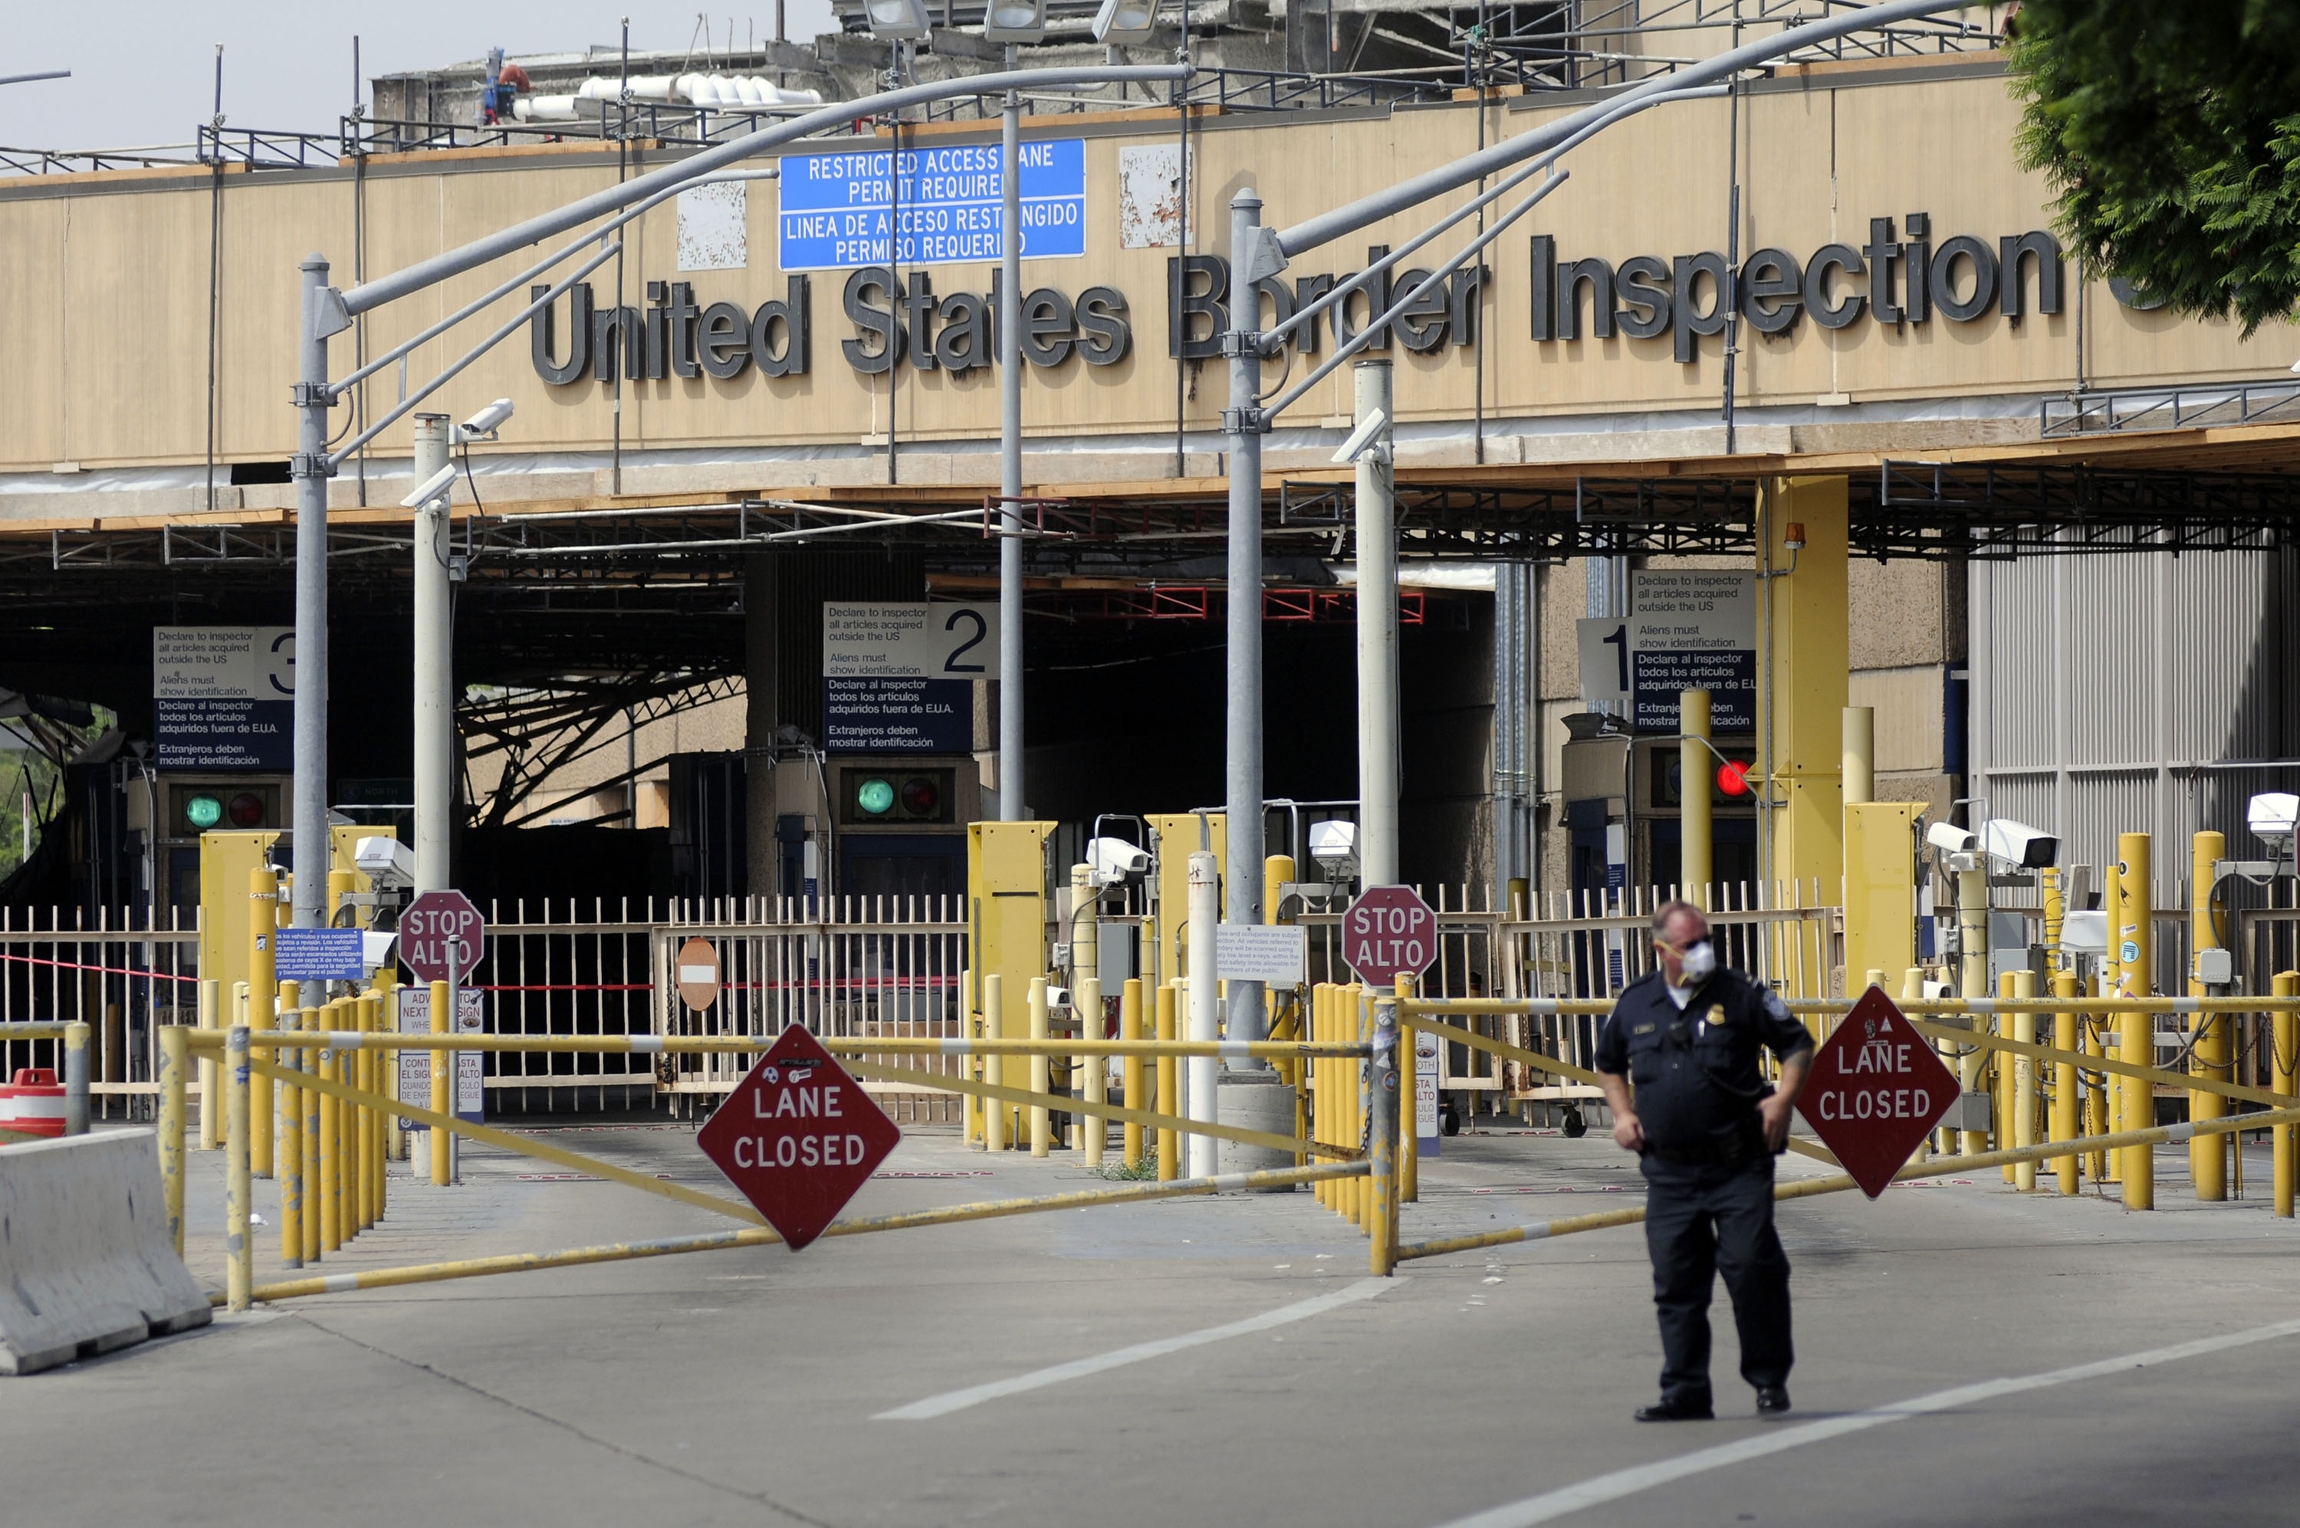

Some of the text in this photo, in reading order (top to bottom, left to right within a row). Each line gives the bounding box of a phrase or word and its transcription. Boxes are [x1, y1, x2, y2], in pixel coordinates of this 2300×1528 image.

[809, 144, 1054, 180] RESTRICTED ACCESS ANE
[849, 173, 1004, 204] PERMIT REQUIRE
[786, 202, 1078, 240] LINEA DE ACCESO RESTNGIDO
[836, 232, 1027, 263] PERMISO REQUERIO
[531, 273, 808, 386] United
[1530, 211, 2064, 364] Inspection
[1638, 576, 1743, 588] Declare to inspector
[1638, 588, 1738, 600] all articles acquired
[1638, 601, 1714, 612] outside the US
[829, 607, 927, 619] Declare to inspector
[829, 620, 923, 631] all articles acquired
[1639, 625, 1700, 635] Aliens must
[158, 631, 253, 644] Declare to inspector
[829, 631, 900, 641] outside the US
[944, 608, 987, 672] 2
[1639, 637, 1736, 648] show identification
[159, 643, 250, 654] all articles acquired
[158, 654, 227, 664] outside the US
[830, 653, 887, 662] Aliens must
[1603, 624, 1629, 692] 1
[1638, 654, 1742, 665] Declare al inspector
[830, 665, 921, 675] show identification
[1639, 667, 1669, 677] todos
[1672, 667, 1688, 677] los
[160, 675, 215, 684] Aliens must
[829, 679, 927, 690] Declare al inspector
[1696, 679, 1722, 690] fuera
[1725, 679, 1739, 689] de
[160, 687, 247, 696] show identification
[829, 692, 858, 702] todos
[860, 692, 875, 701] los
[159, 701, 253, 712] Declare al inspector
[829, 704, 880, 715] adquiridos
[882, 704, 908, 714] fuera
[910, 704, 923, 713] de
[159, 713, 187, 722] todos
[189, 713, 204, 721] los
[1639, 716, 1679, 726] mostrar
[159, 723, 208, 734] adquiridos
[211, 724, 235, 733] fuera
[237, 724, 250, 733] de
[829, 725, 918, 736] Extranjeros deben
[829, 738, 867, 747] mostrar
[159, 744, 245, 755] Extranjeros deben
[159, 754, 196, 765] mostrar
[409, 910, 474, 935] STOP
[1354, 907, 1426, 935] STOP
[411, 940, 472, 965] ALTO
[1356, 939, 1424, 967] ALTO
[403, 1007, 427, 1017] NEXT
[1838, 1044, 1912, 1074] LANE
[402, 1070, 412, 1078] EL
[754, 1086, 843, 1119] LANE
[1819, 1088, 1931, 1122] CLOSED
[734, 1133, 866, 1169] CLOSED
